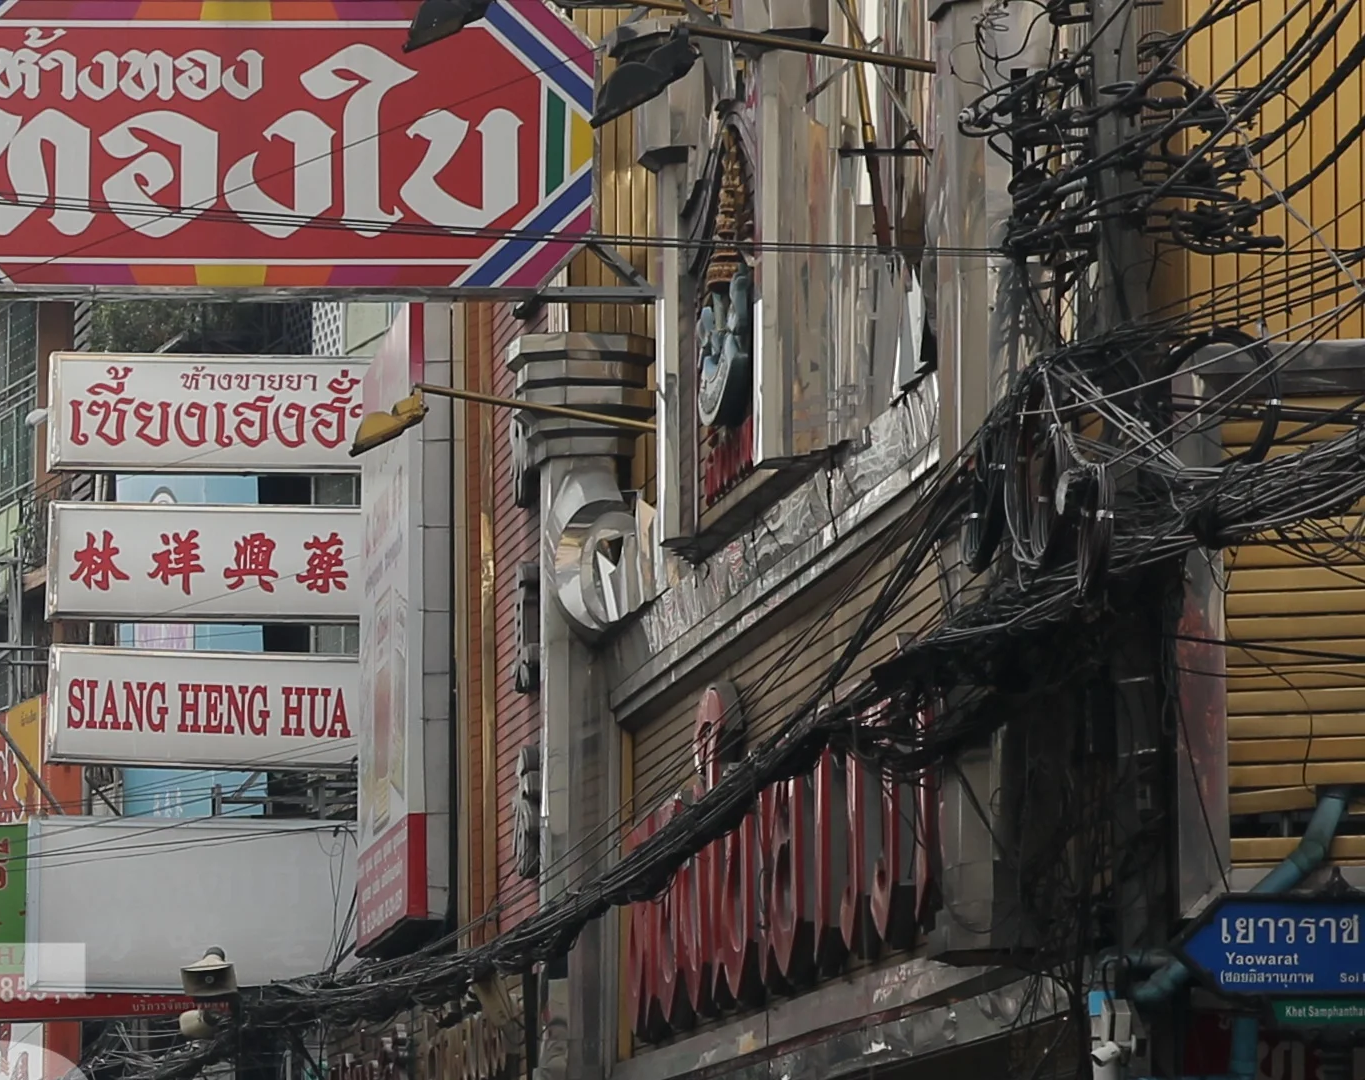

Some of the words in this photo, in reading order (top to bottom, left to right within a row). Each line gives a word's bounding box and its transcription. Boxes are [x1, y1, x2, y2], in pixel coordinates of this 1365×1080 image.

[181, 366, 318, 391] ห้างขายยา
[67, 678, 168, 733] SIANG
[177, 683, 270, 736] HENG
[280, 687, 351, 738] HUA
[1220, 913, 1360, 944] เยาวราช
[1225, 951, 1299, 966] Yaowarat
[1340, 972, 1360, 983] Soi
[1285, 1005, 1307, 1018] Khet
